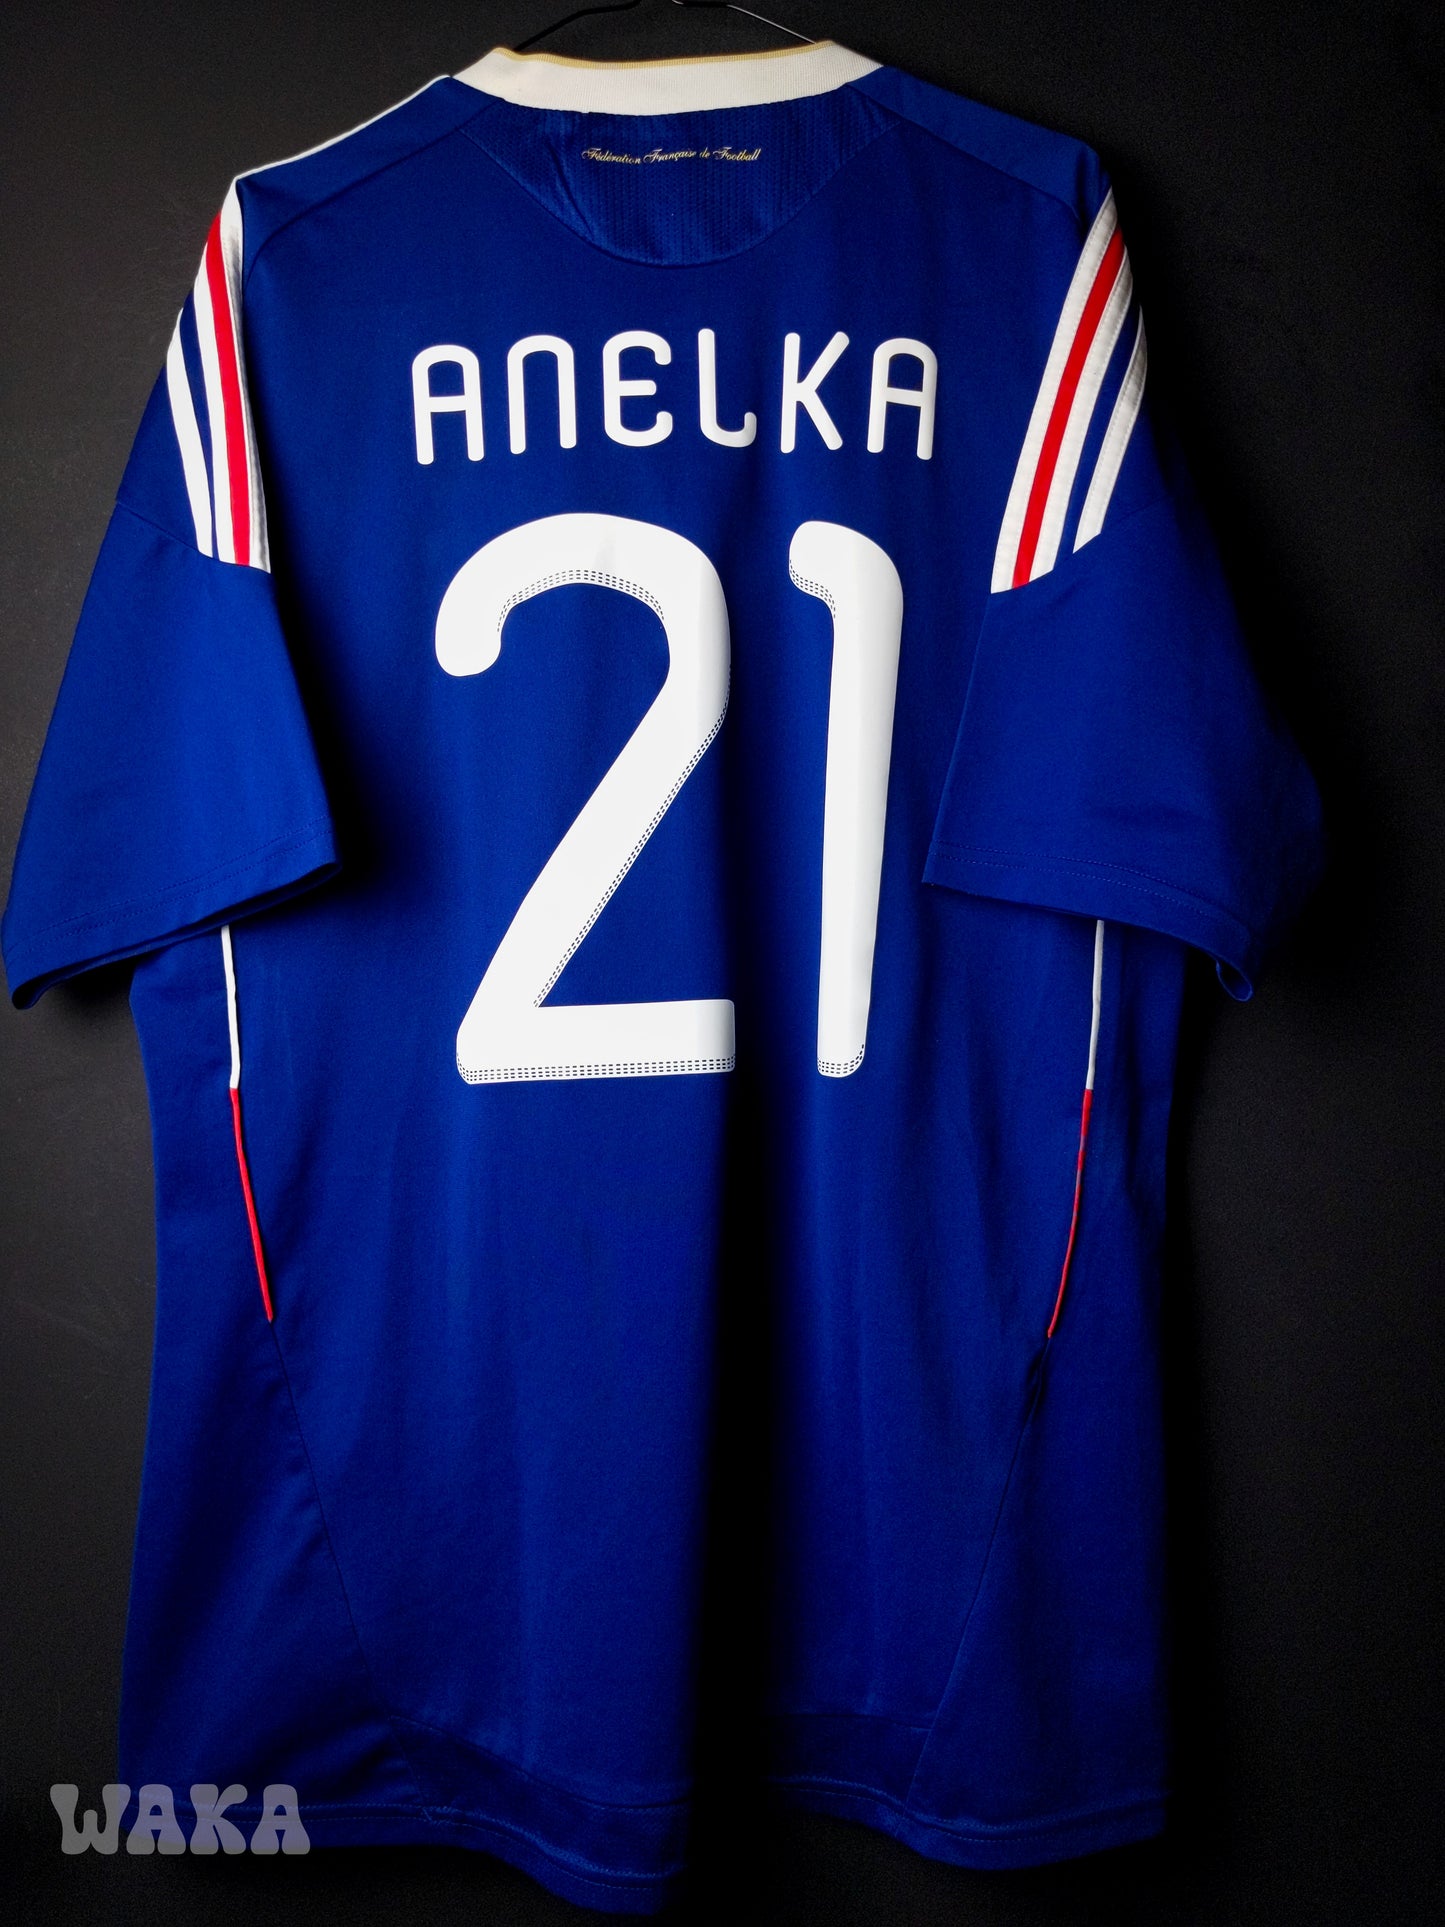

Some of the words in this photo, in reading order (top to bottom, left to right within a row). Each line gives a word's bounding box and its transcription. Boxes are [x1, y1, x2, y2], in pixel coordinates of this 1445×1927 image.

[581, 147, 642, 164] Fédération
[642, 148, 698, 164] Française
[699, 146, 711, 159] de
[712, 146, 762, 162] Football
[411, 329, 938, 465] ANELKA
[434, 512, 905, 1085] 21
